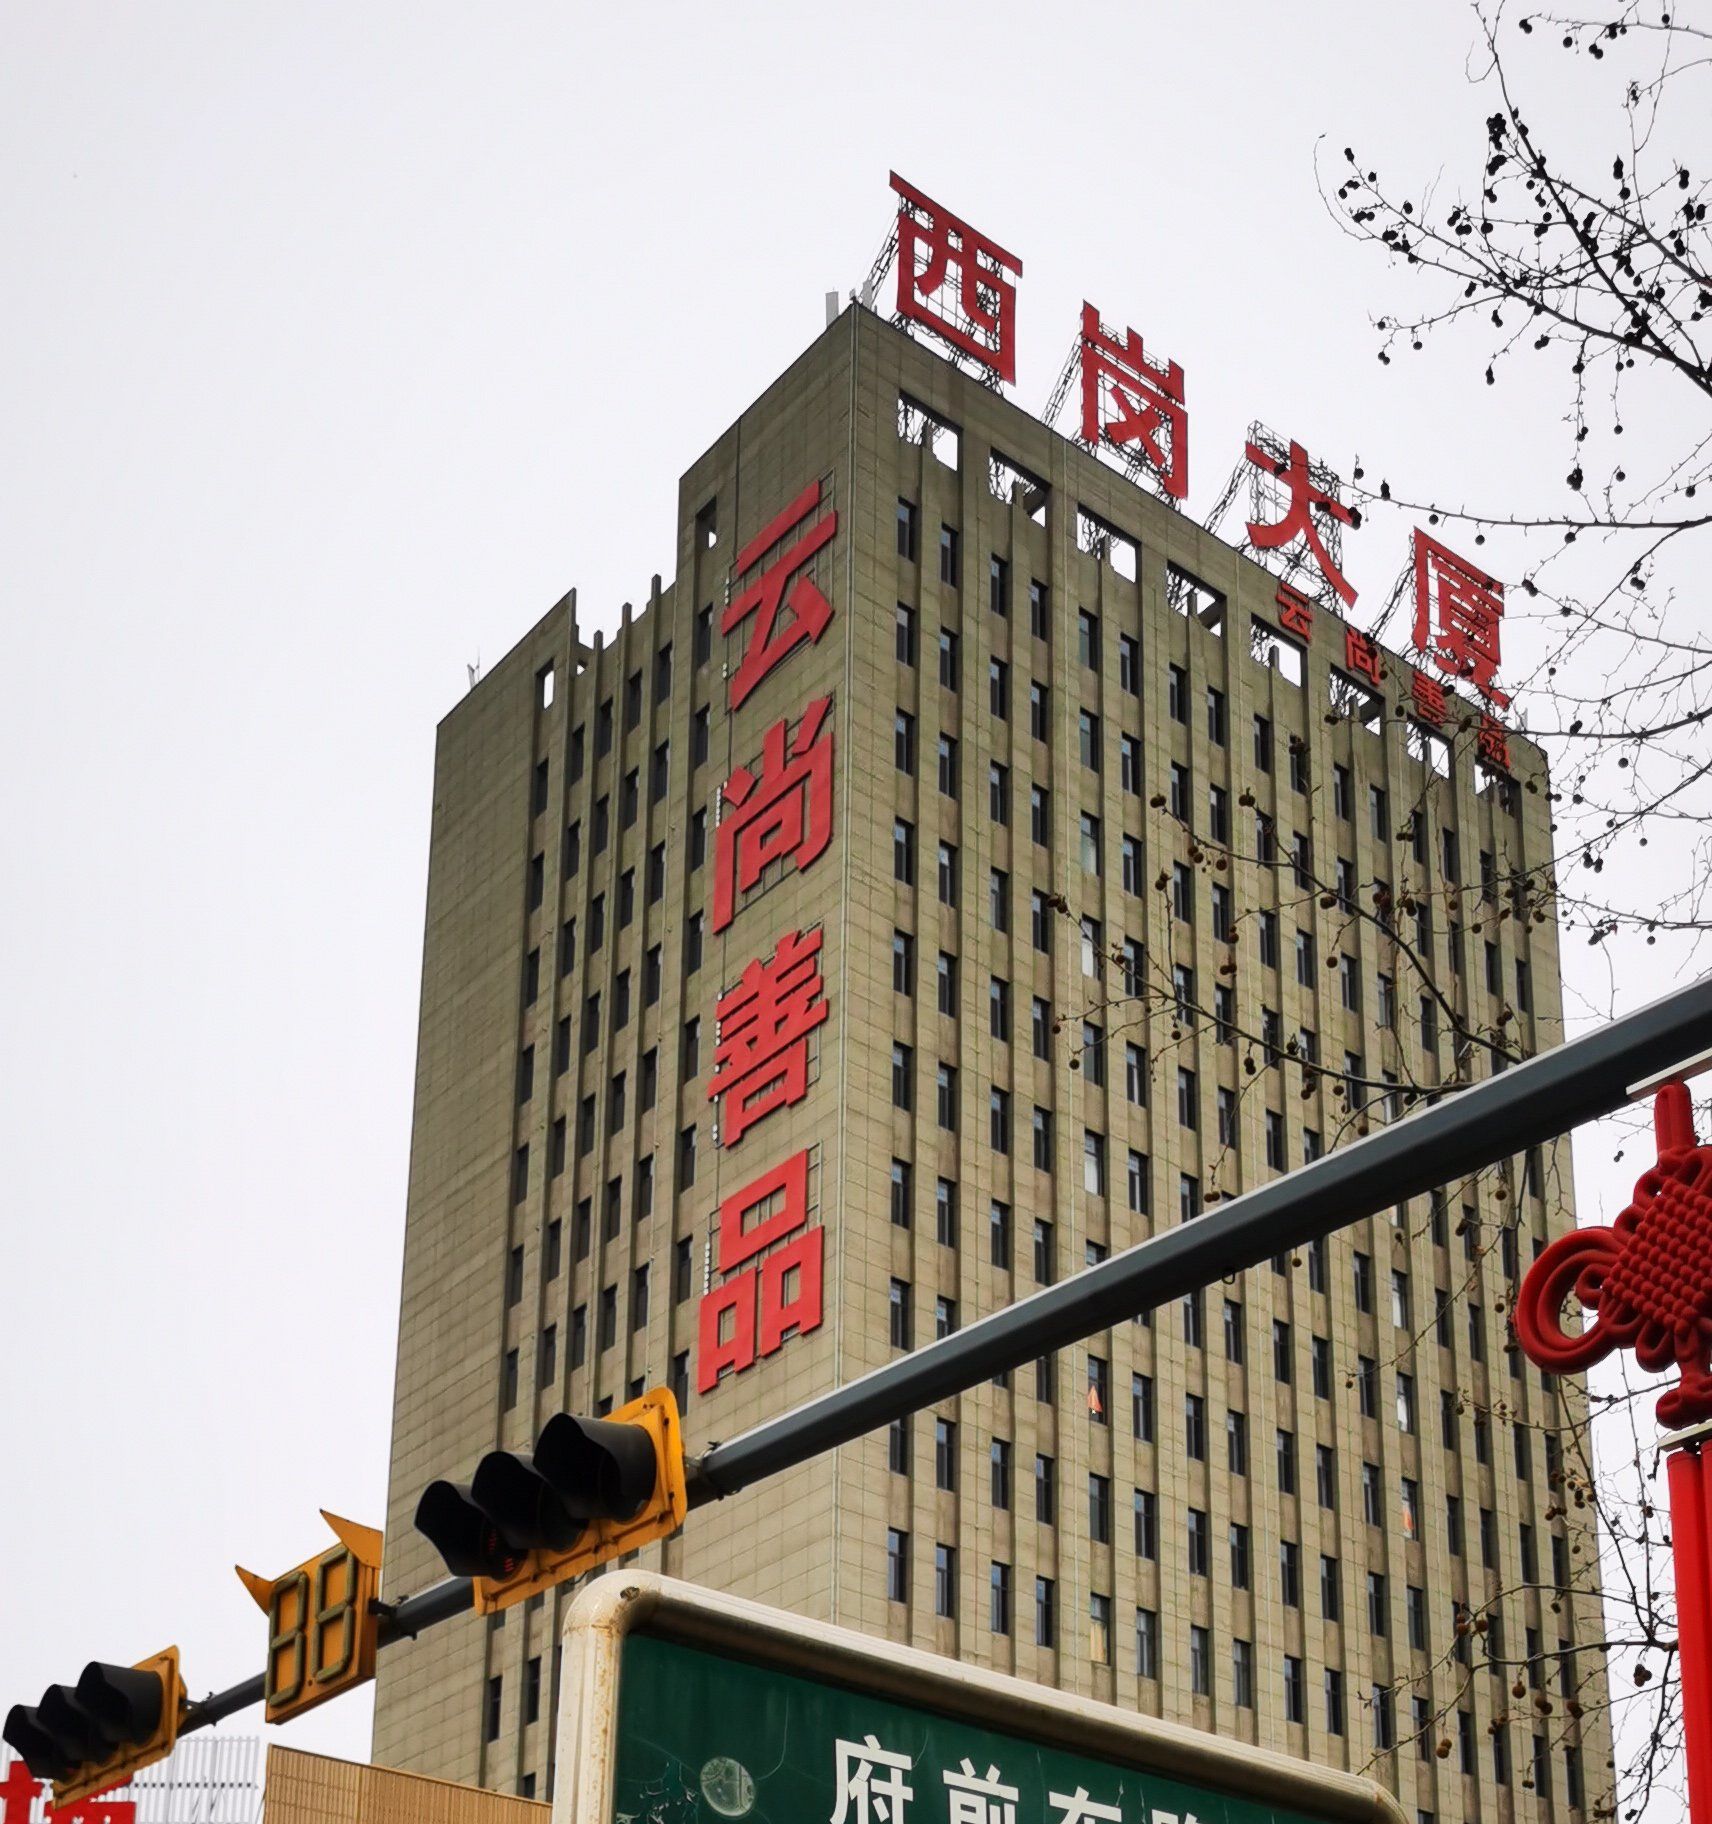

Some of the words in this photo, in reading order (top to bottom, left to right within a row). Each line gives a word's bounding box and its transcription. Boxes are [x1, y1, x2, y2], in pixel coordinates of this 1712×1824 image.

[889, 170, 1511, 709] 西岗大厦
[698, 479, 838, 1395] 云尚善品
